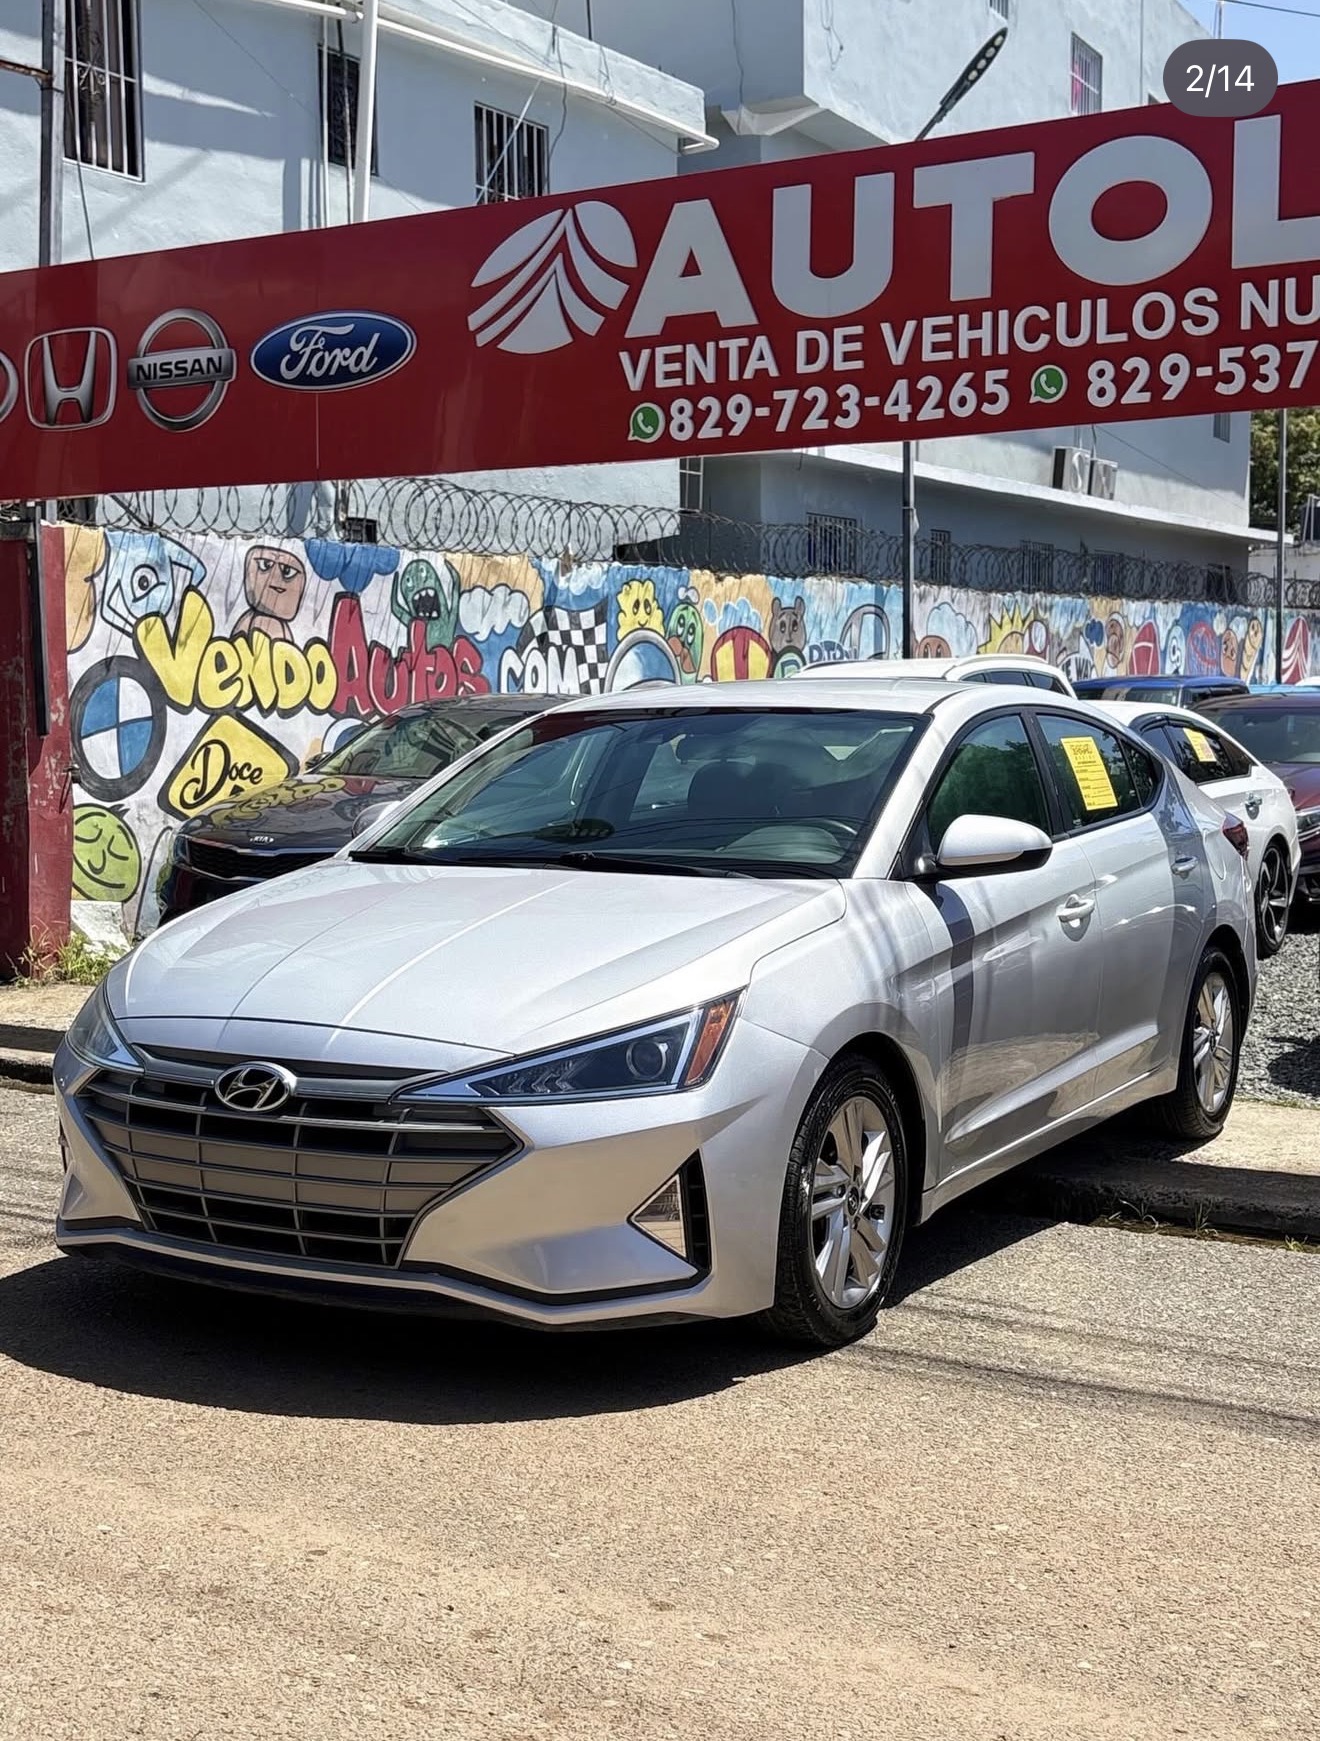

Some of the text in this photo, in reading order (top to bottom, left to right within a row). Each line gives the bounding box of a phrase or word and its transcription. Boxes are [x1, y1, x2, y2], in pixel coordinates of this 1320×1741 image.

[626, 113, 1320, 338] AUTOL
[136, 355, 223, 382] NISSAN
[280, 323, 381, 380] Ford
[619, 274, 1320, 392] VENTA DE VEHICULOS NU
[669, 340, 1319, 442] 829-723-4265 829-537
[179, 738, 264, 810] Doce
